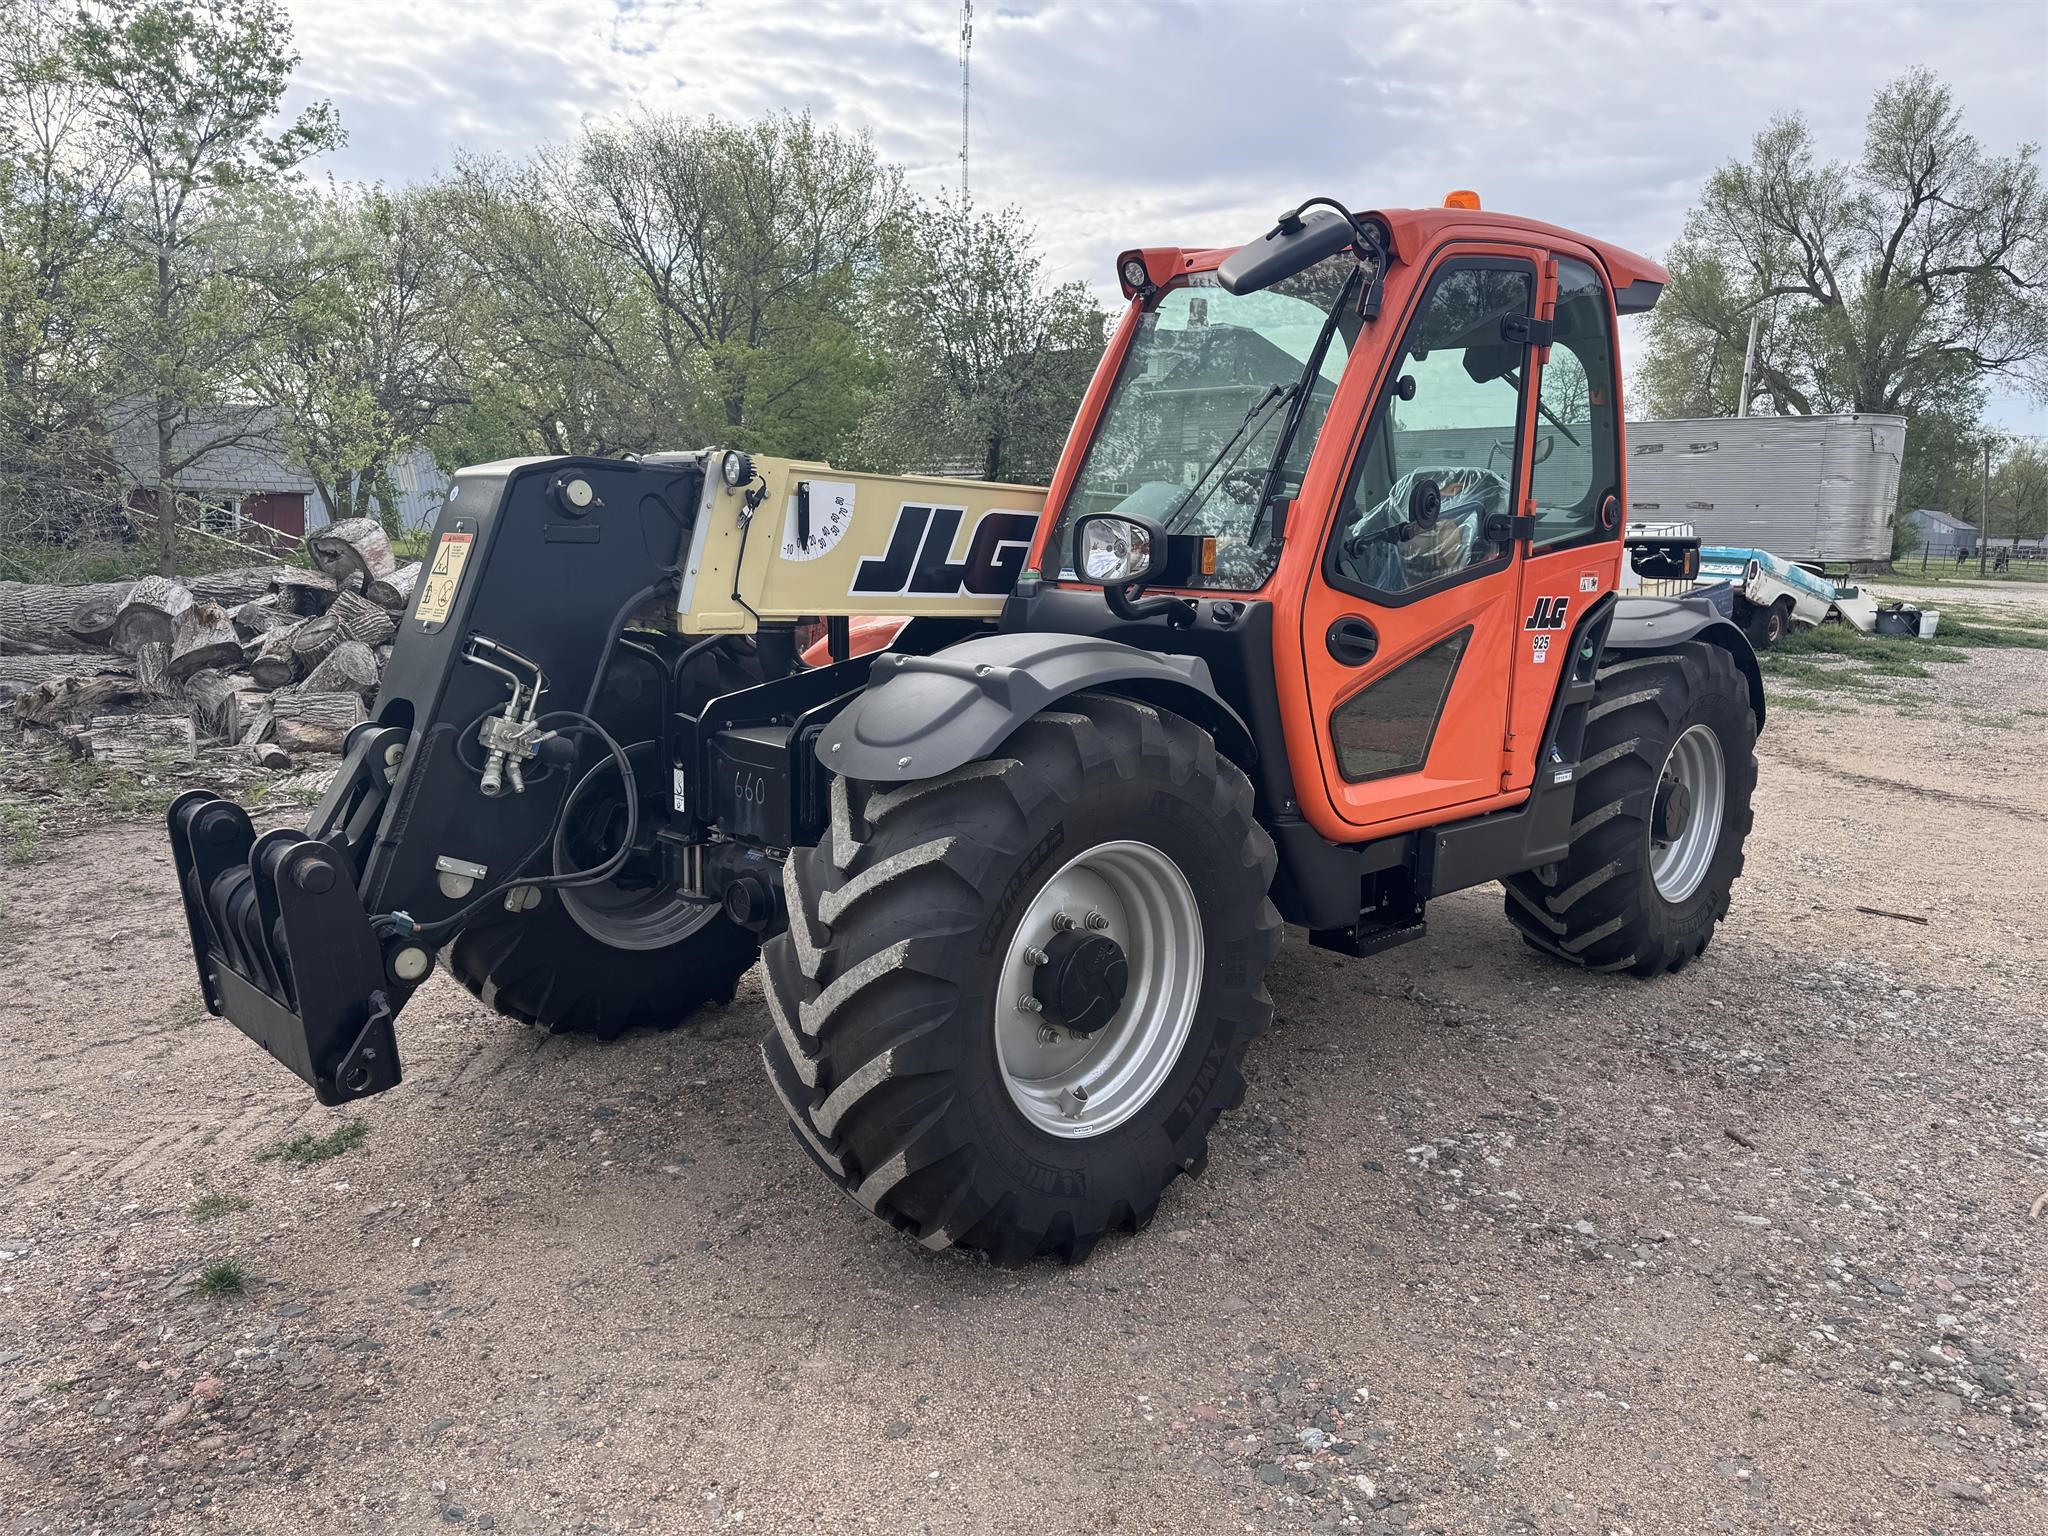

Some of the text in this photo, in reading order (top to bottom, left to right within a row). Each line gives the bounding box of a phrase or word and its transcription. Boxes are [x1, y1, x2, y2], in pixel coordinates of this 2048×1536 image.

[835, 496, 845, 506] 80
[830, 512, 840, 523] 60
[838, 507, 848, 517] 70
[821, 526, 831, 537] 40
[830, 525, 840, 536] 50
[808, 534, 817, 547] 20
[818, 537, 827, 549] 30
[783, 543, 794, 555] -10
[848, 502, 1042, 597] JLG
[1525, 597, 1569, 630] JLG
[1533, 636, 1550, 649] 925
[734, 771, 765, 805] 660
